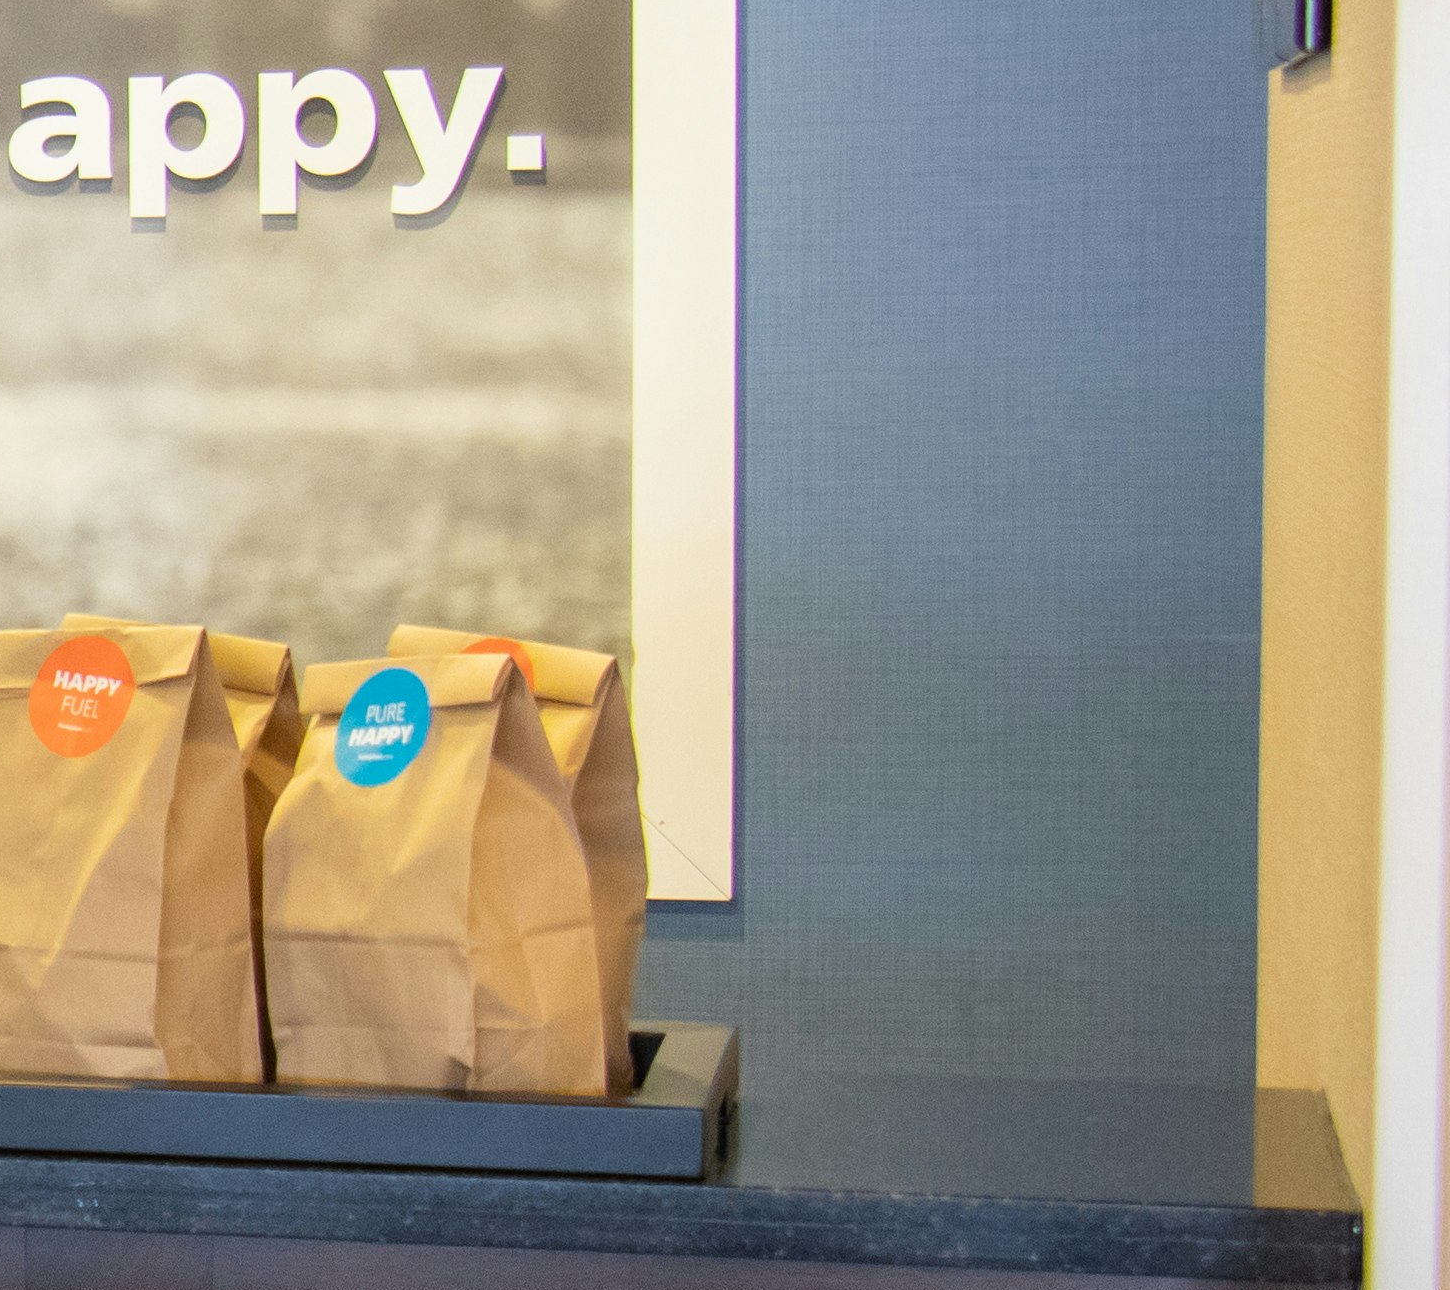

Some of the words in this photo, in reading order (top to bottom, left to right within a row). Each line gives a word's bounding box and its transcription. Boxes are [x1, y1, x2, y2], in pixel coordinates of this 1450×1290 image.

[53, 669, 123, 697] HAPPY
[61, 695, 99, 719] FUEL
[365, 701, 407, 723] PURE
[348, 723, 414, 747] HAPPY
